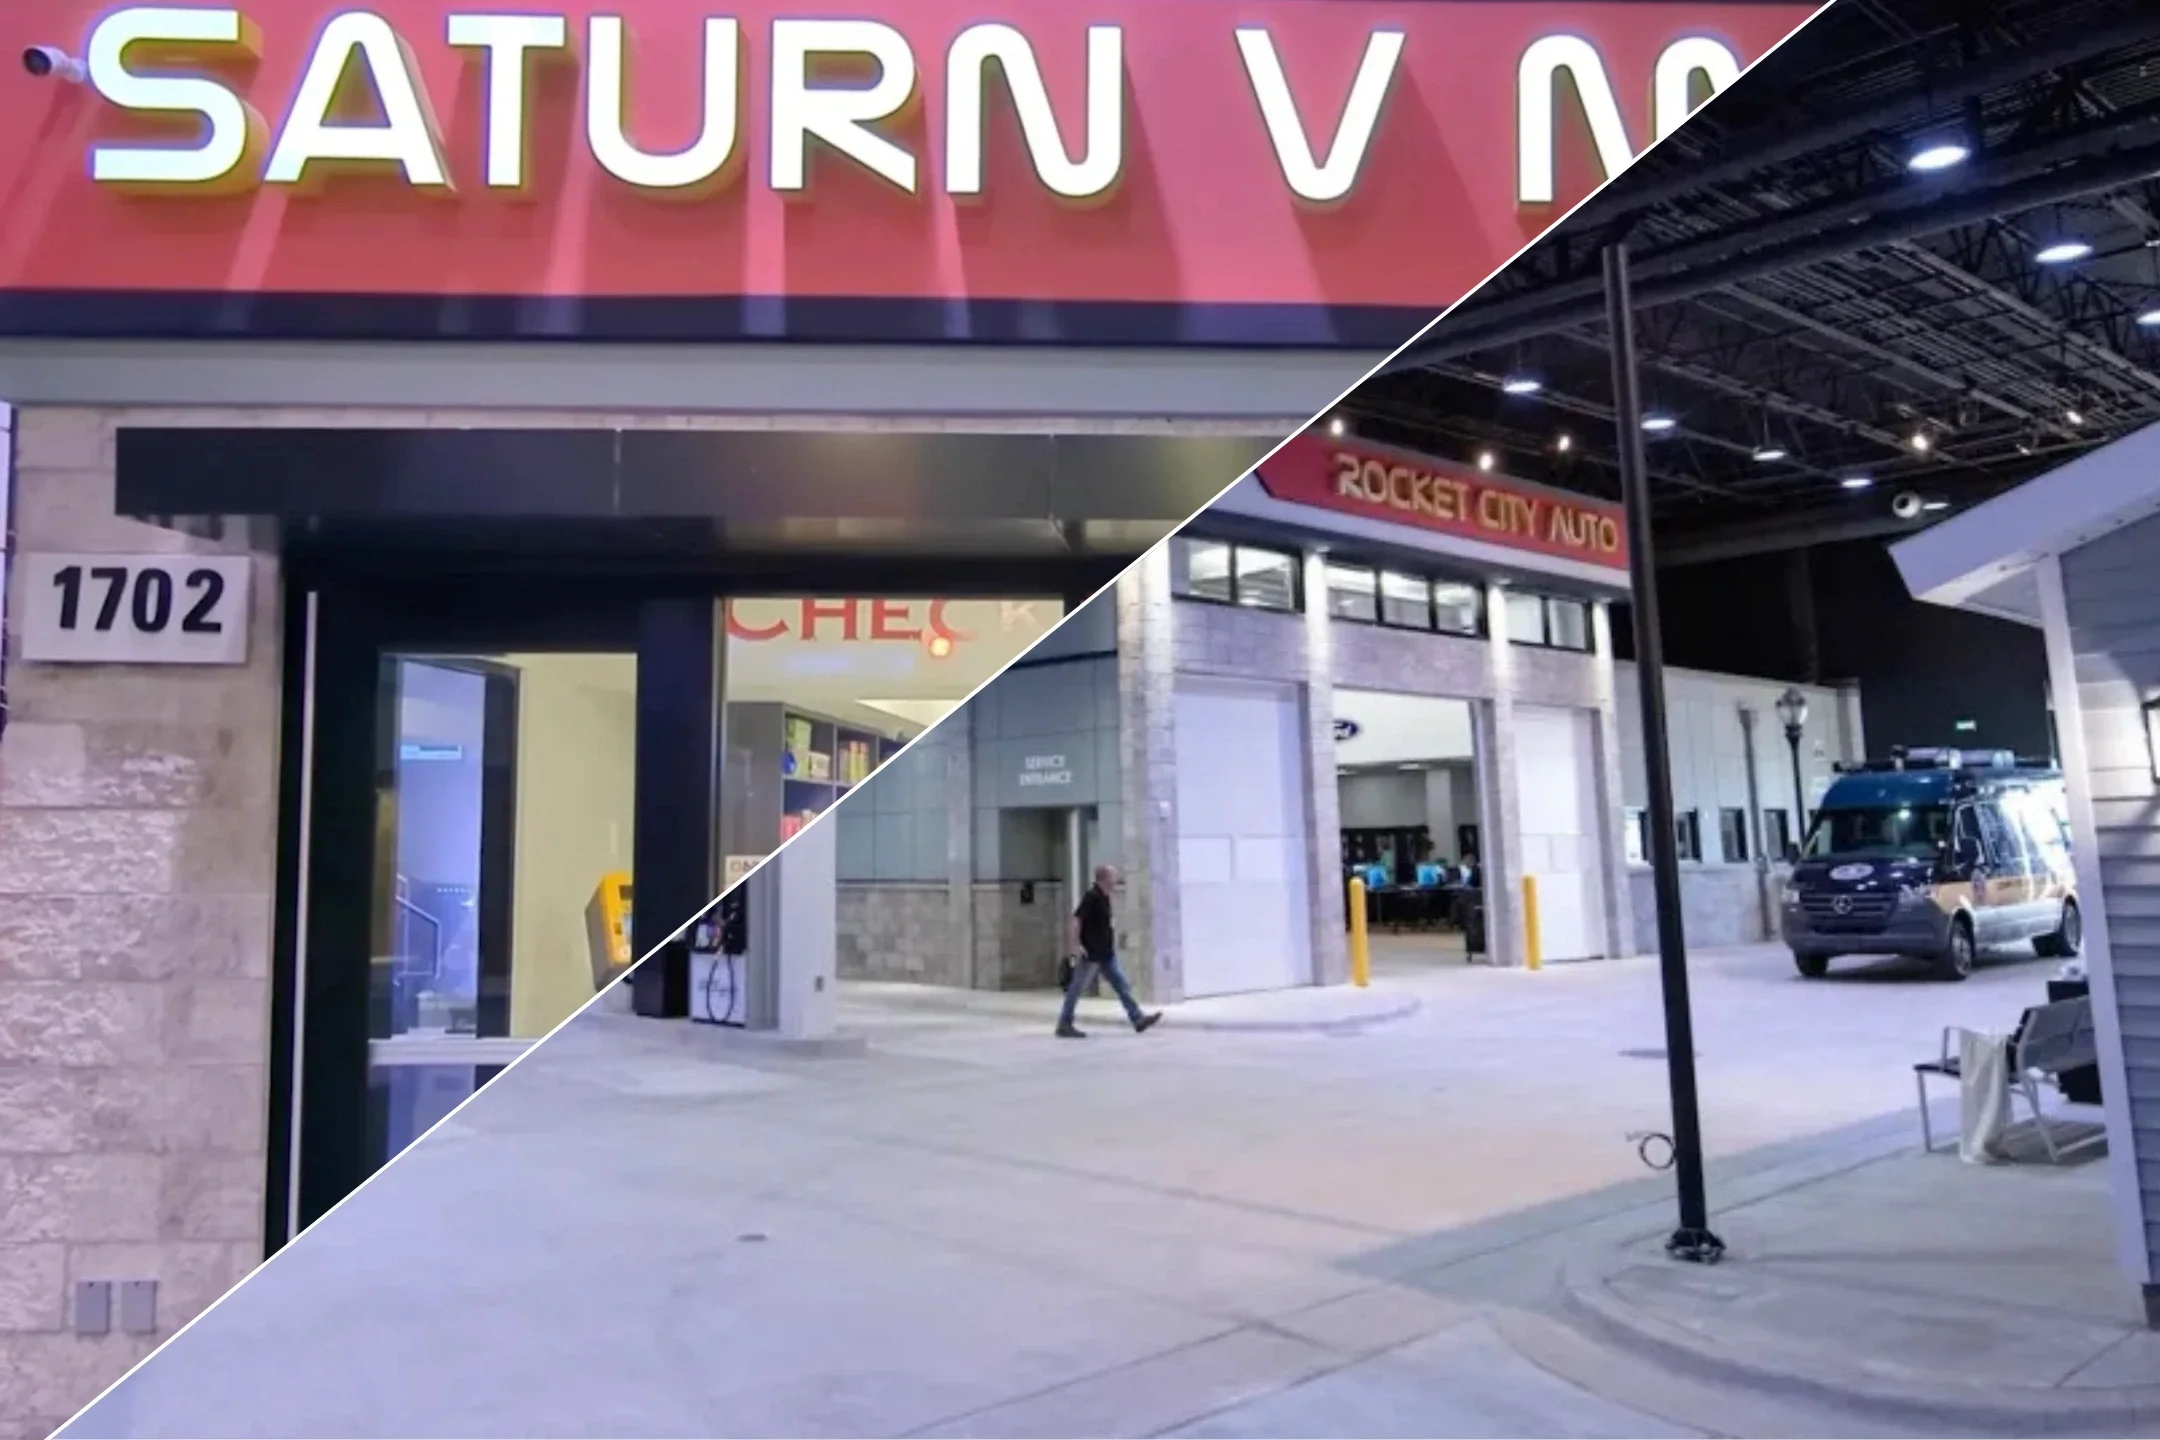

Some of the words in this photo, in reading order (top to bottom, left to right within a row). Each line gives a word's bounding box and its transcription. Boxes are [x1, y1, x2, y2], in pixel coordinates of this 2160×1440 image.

[87, 8, 1123, 197] SATURN
[1235, 28, 1405, 201] V
[1336, 452, 1470, 522] ROCKET
[1478, 489, 1539, 537] CITY
[1550, 504, 1619, 553] AUTO
[53, 565, 225, 634] 1702
[1019, 770, 1072, 787] ENTRANCE
